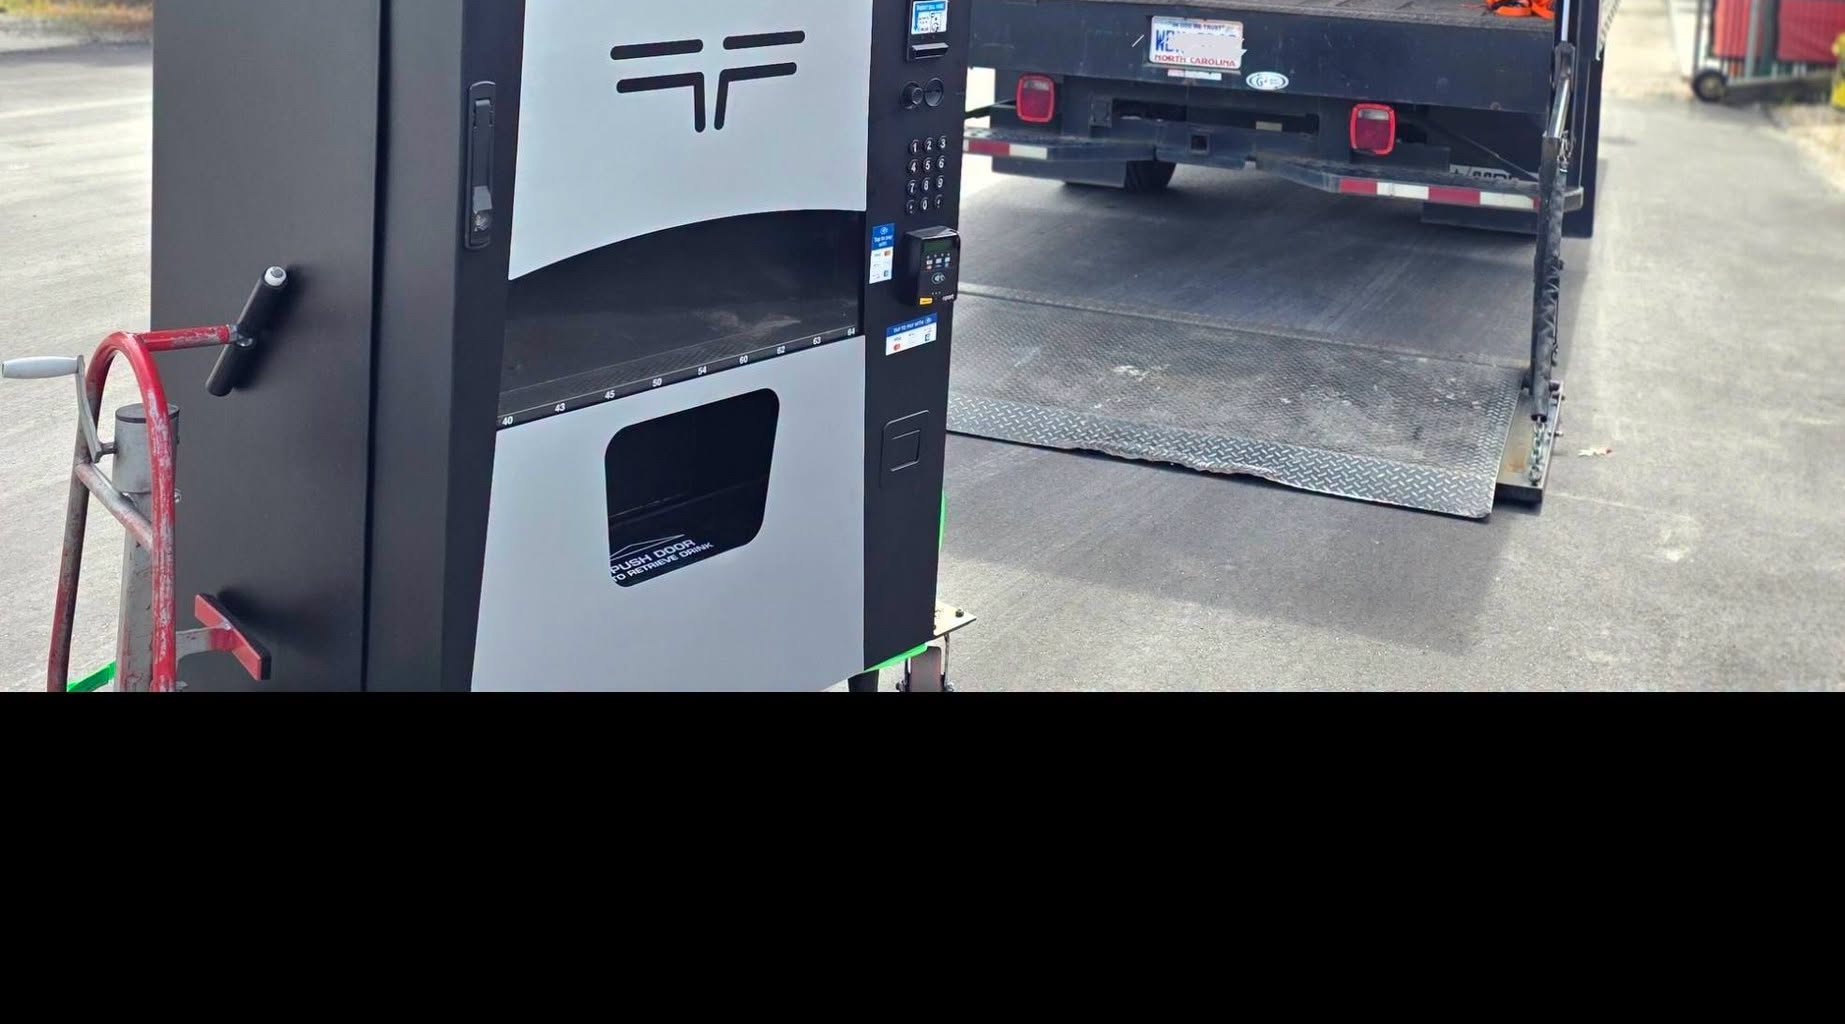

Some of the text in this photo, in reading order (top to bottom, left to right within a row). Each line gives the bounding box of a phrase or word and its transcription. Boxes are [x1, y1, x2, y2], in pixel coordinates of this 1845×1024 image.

[1154, 54, 1236, 67] NORTH CAROLINA
[502, 328, 856, 425] 40 43 45 50 54 60 62 63 64
[610, 539, 696, 574] PUSH DOOR
[611, 542, 714, 582] TO RETRIEVE DRINK
